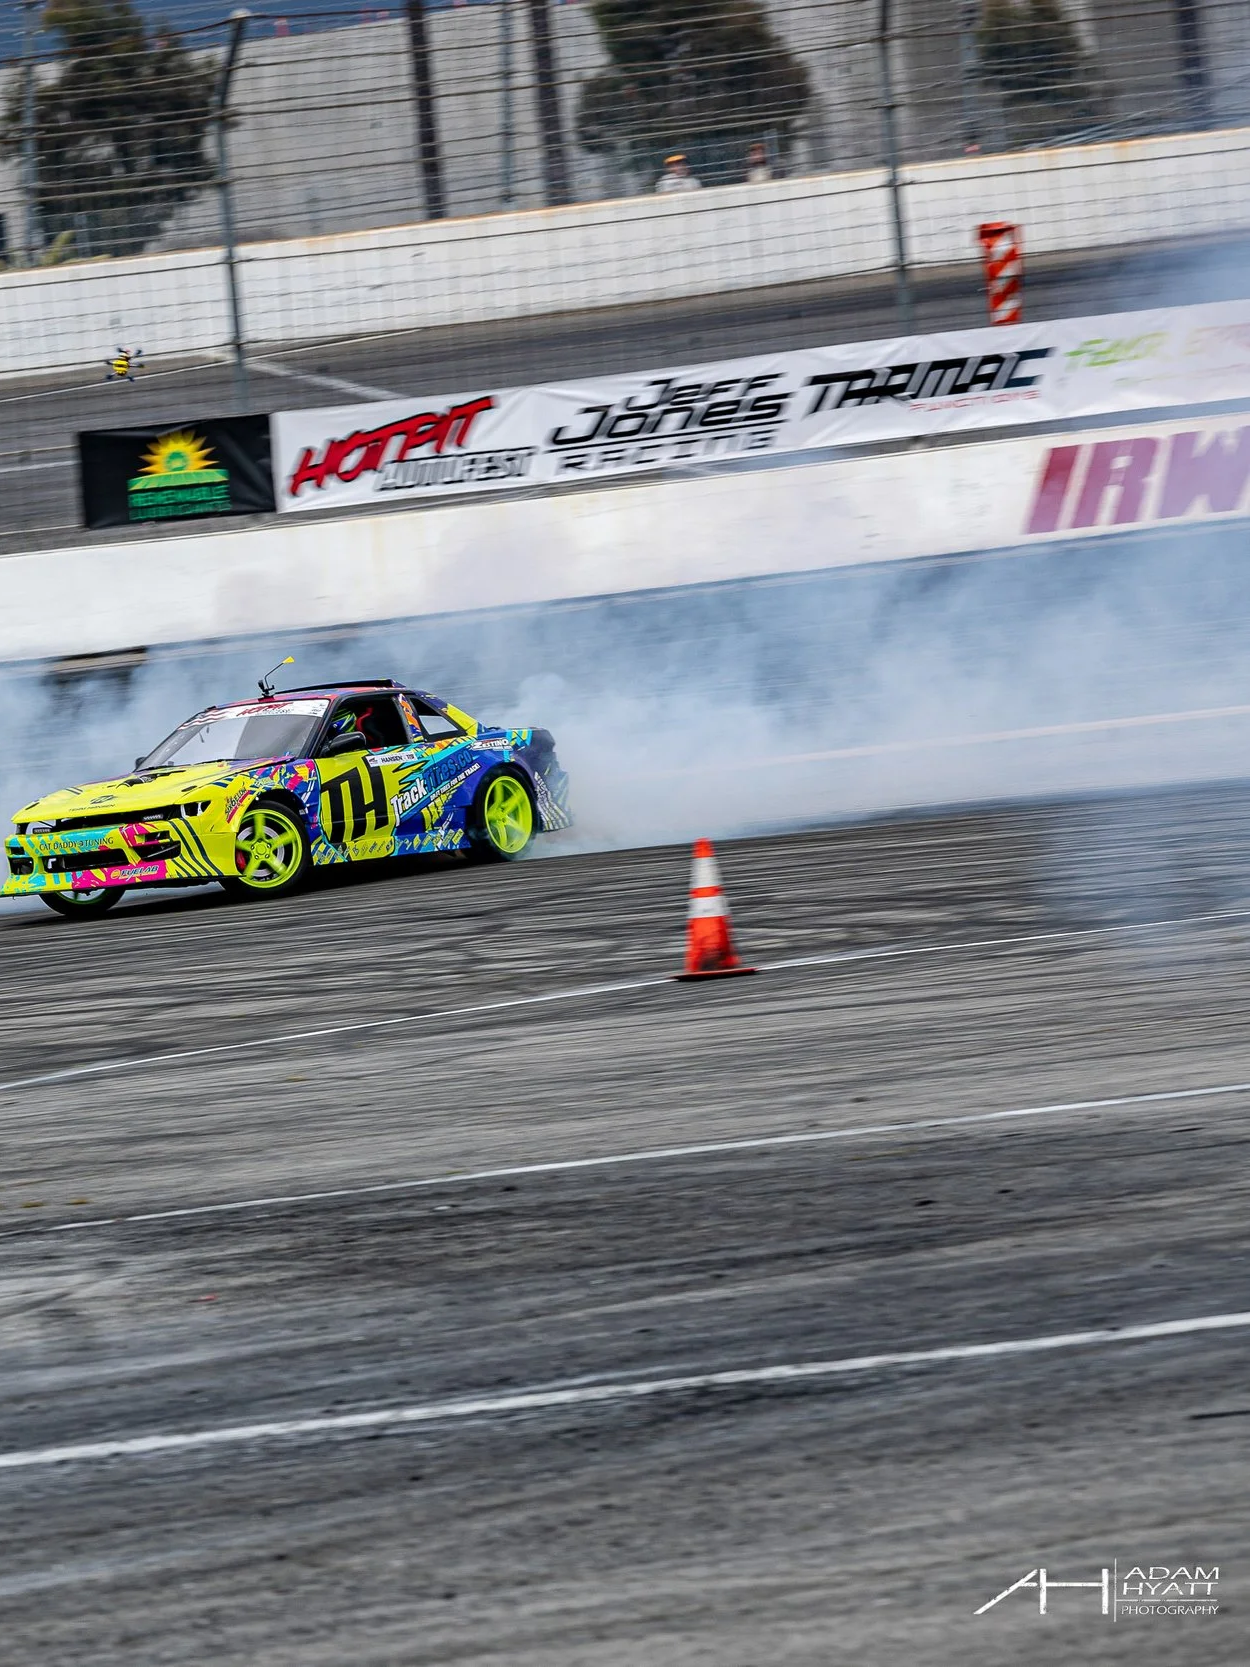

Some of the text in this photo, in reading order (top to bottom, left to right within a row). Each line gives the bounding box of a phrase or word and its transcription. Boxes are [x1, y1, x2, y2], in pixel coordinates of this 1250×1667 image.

[288, 395, 498, 497] HOTPIT
[473, 738, 509, 749] ZESTINO
[54, 840, 78, 850] DADDY
[84, 837, 114, 847] TUNING
